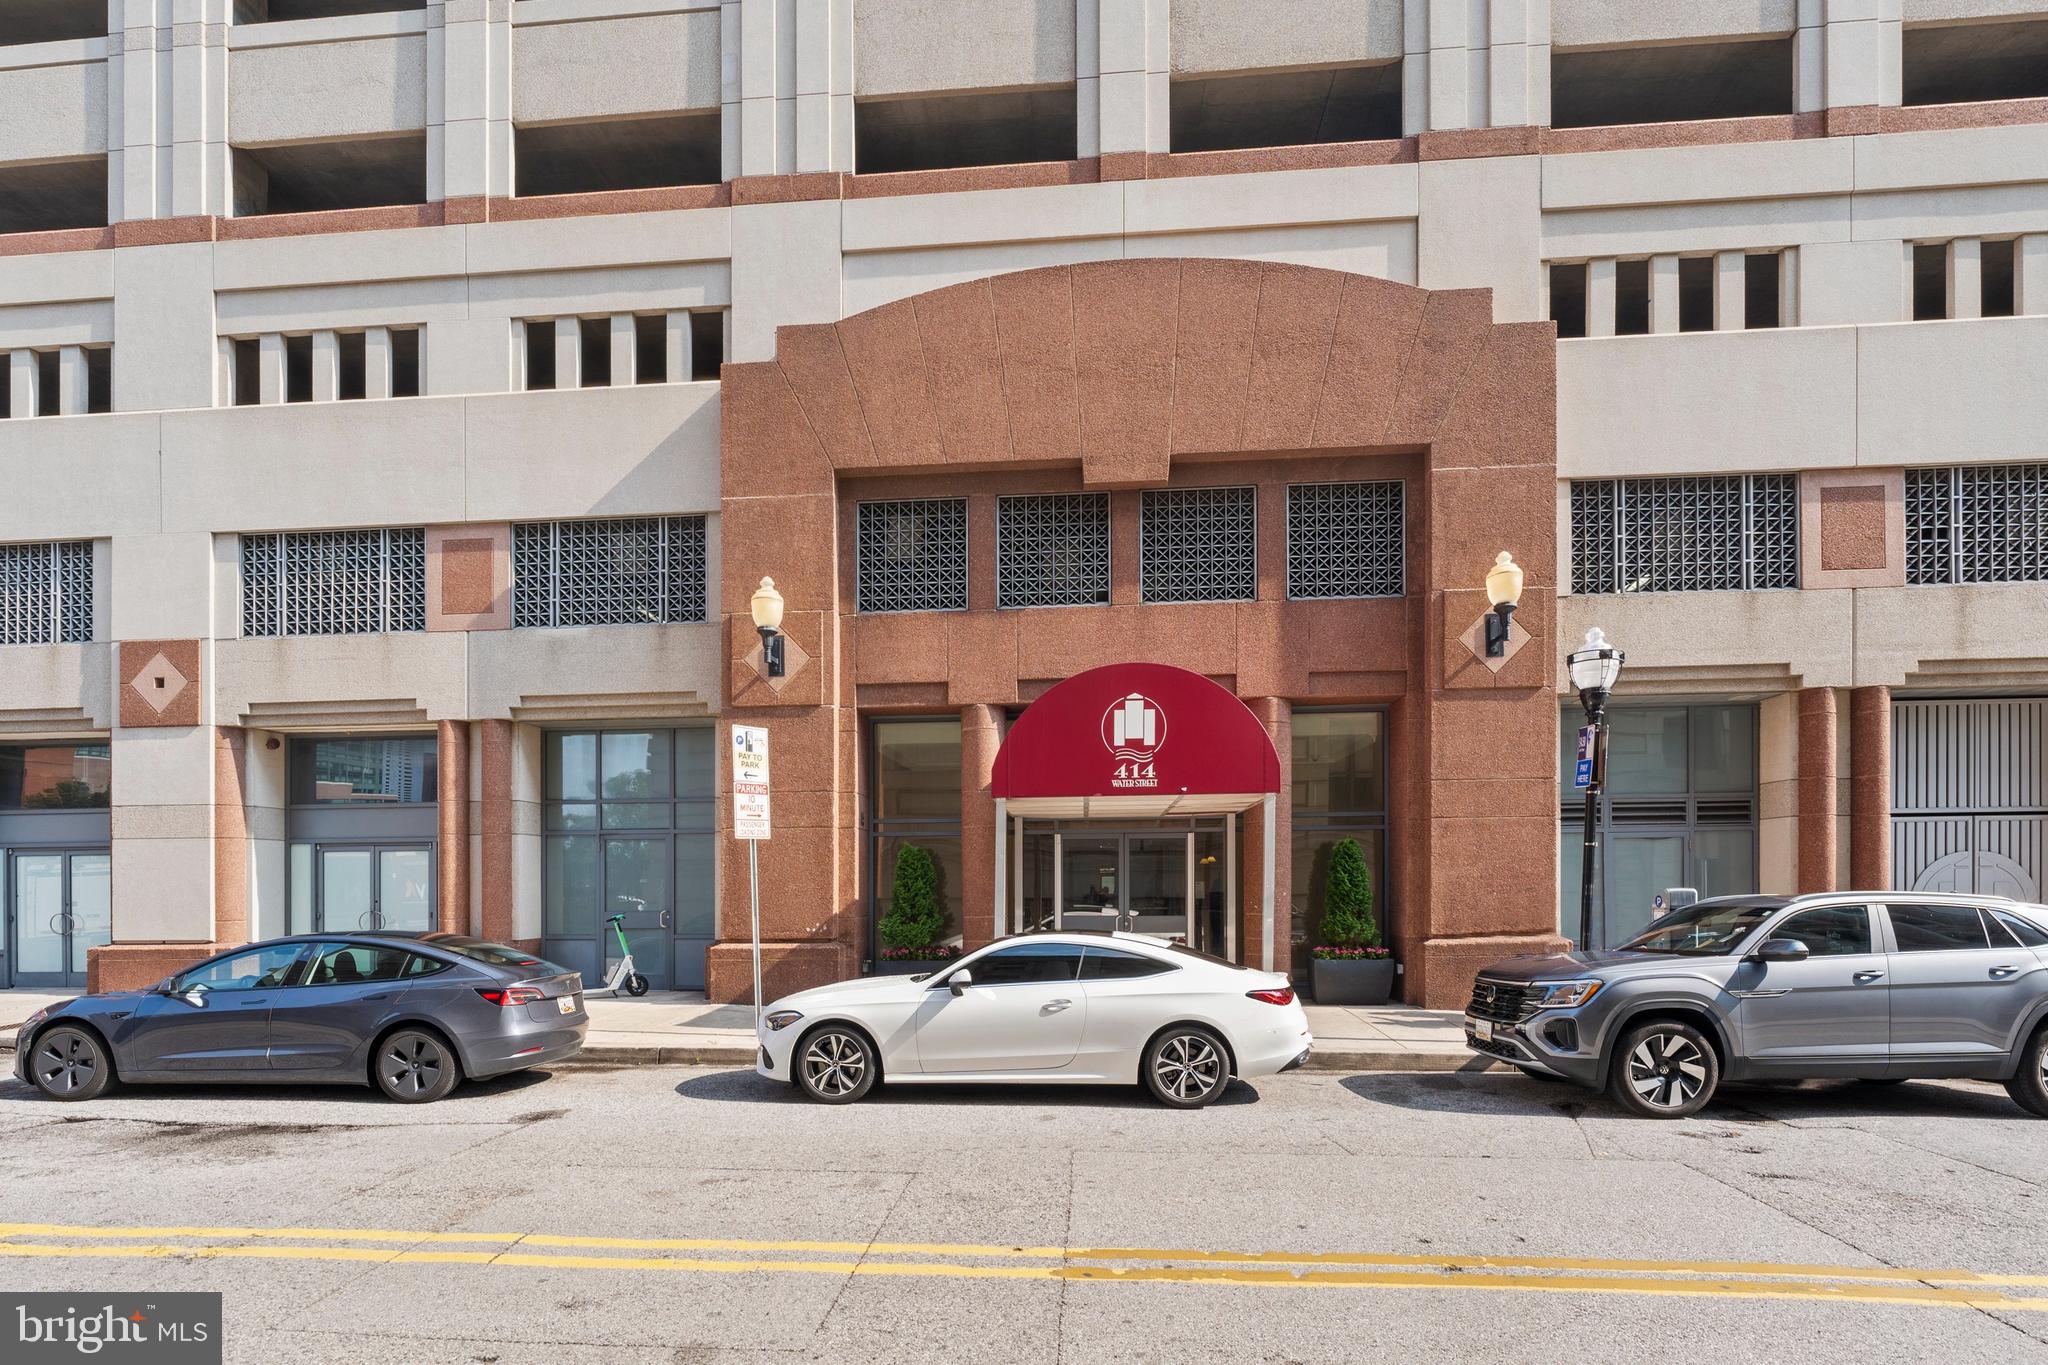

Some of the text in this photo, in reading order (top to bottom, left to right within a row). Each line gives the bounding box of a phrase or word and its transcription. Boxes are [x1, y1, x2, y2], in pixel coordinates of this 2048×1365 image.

[738, 752, 763, 762] PAY TO
[740, 760, 760, 769] PARK
[1579, 764, 1588, 773] PAY
[1113, 762, 1156, 779] 414
[1111, 779, 1158, 787] WATER STREET
[1577, 774, 1589, 783] HERE
[736, 784, 767, 795] PARKING
[748, 795, 756, 803] 10
[740, 804, 765, 813] MINUTE
